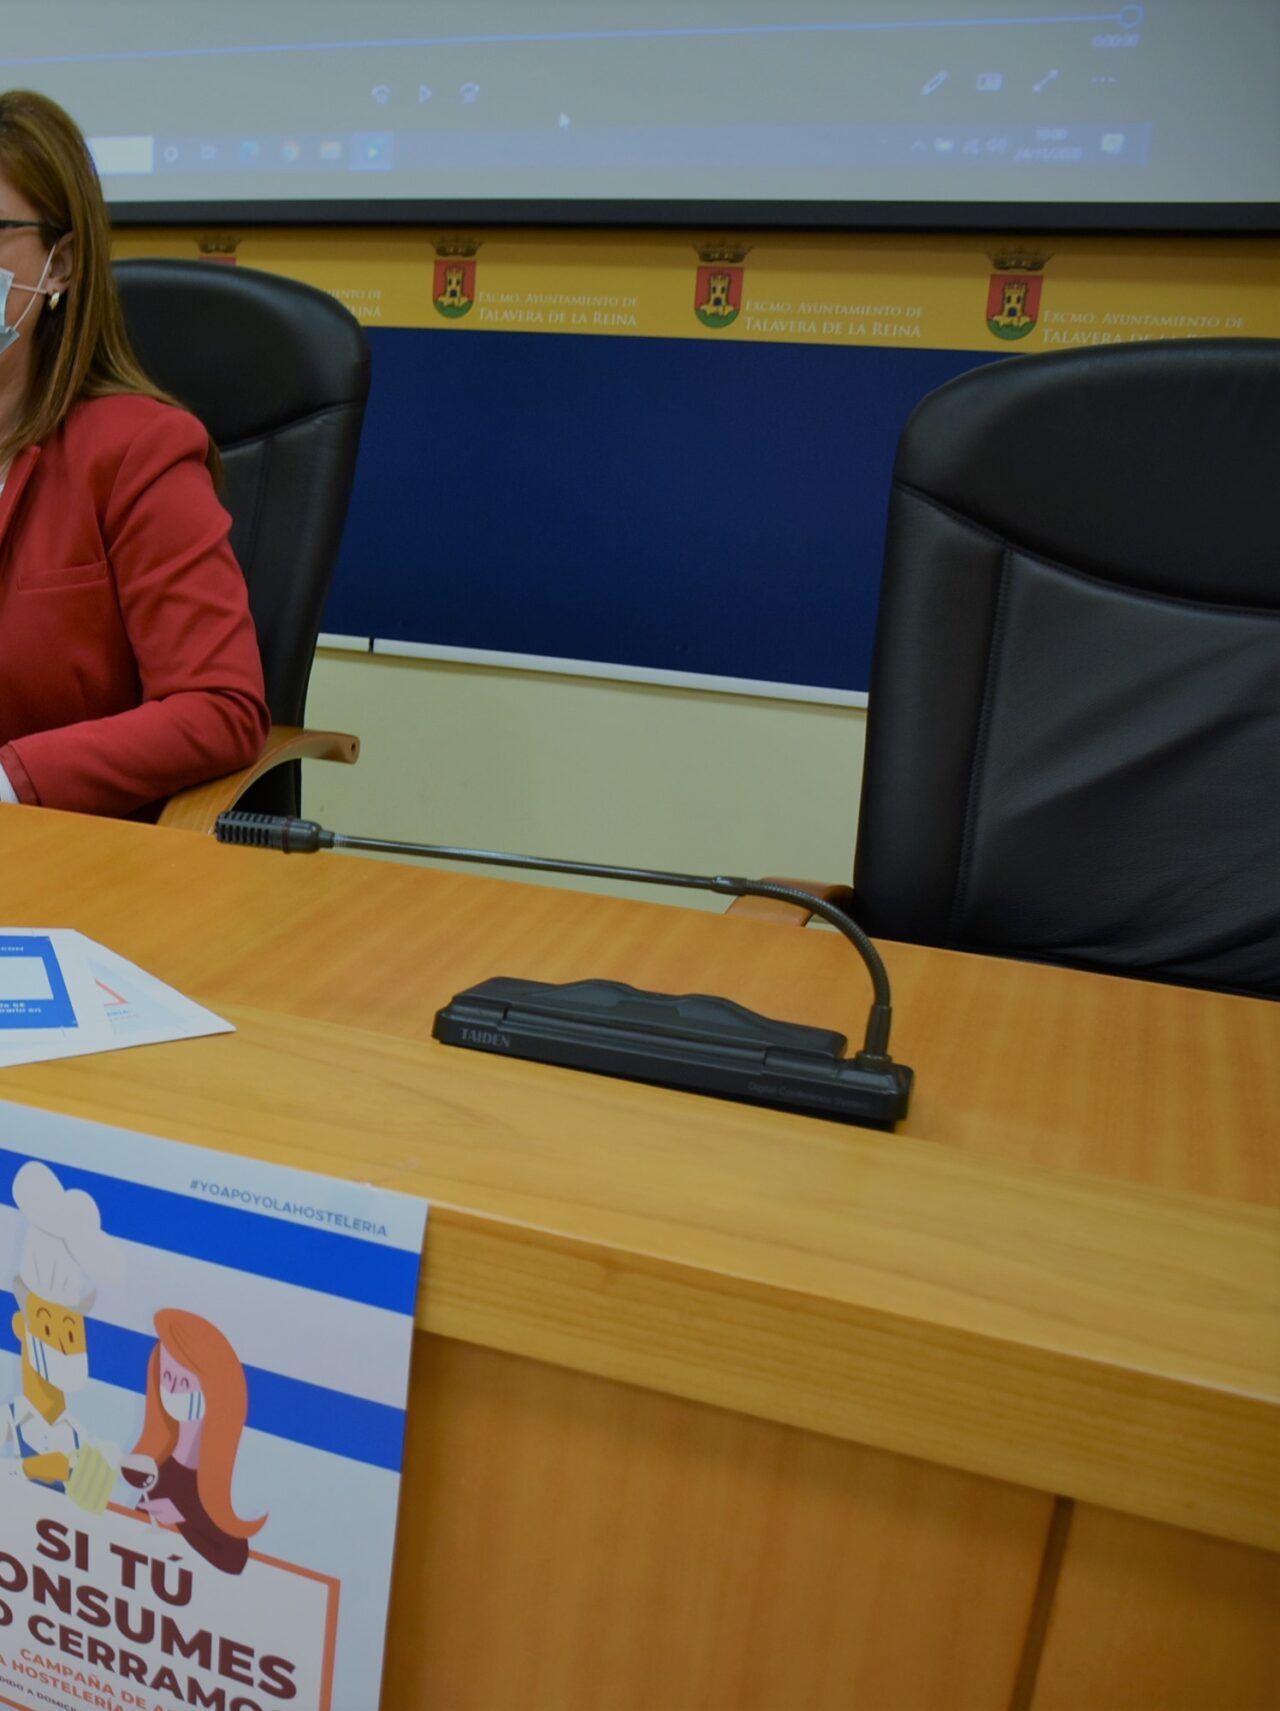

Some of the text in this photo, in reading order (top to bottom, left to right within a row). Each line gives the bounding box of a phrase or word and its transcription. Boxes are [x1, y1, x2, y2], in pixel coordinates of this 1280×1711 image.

[526, 293, 620, 307] AYUNTAMIENTO
[798, 302, 902, 317] AYUNTAMIENTO
[905, 306, 924, 319] DE
[478, 307, 637, 327] TALAVERA DE LA REINA
[745, 316, 921, 337] TALAVERA DE LA REINA
[1102, 312, 1220, 328] AYUNTAMIENTO
[1225, 316, 1245, 329] DE
[458, 1027, 511, 1048] TAIDEN
[190, 1179, 387, 1237] #YOAPOYOLAHOSTELERIA
[35, 1518, 194, 1607] SI TÚ
[27, 1614, 280, 1711] CERRAM
[11, 1659, 124, 1711] HOSTELERÍA
[20, 1648, 147, 1710] CAMPAÑA DE
